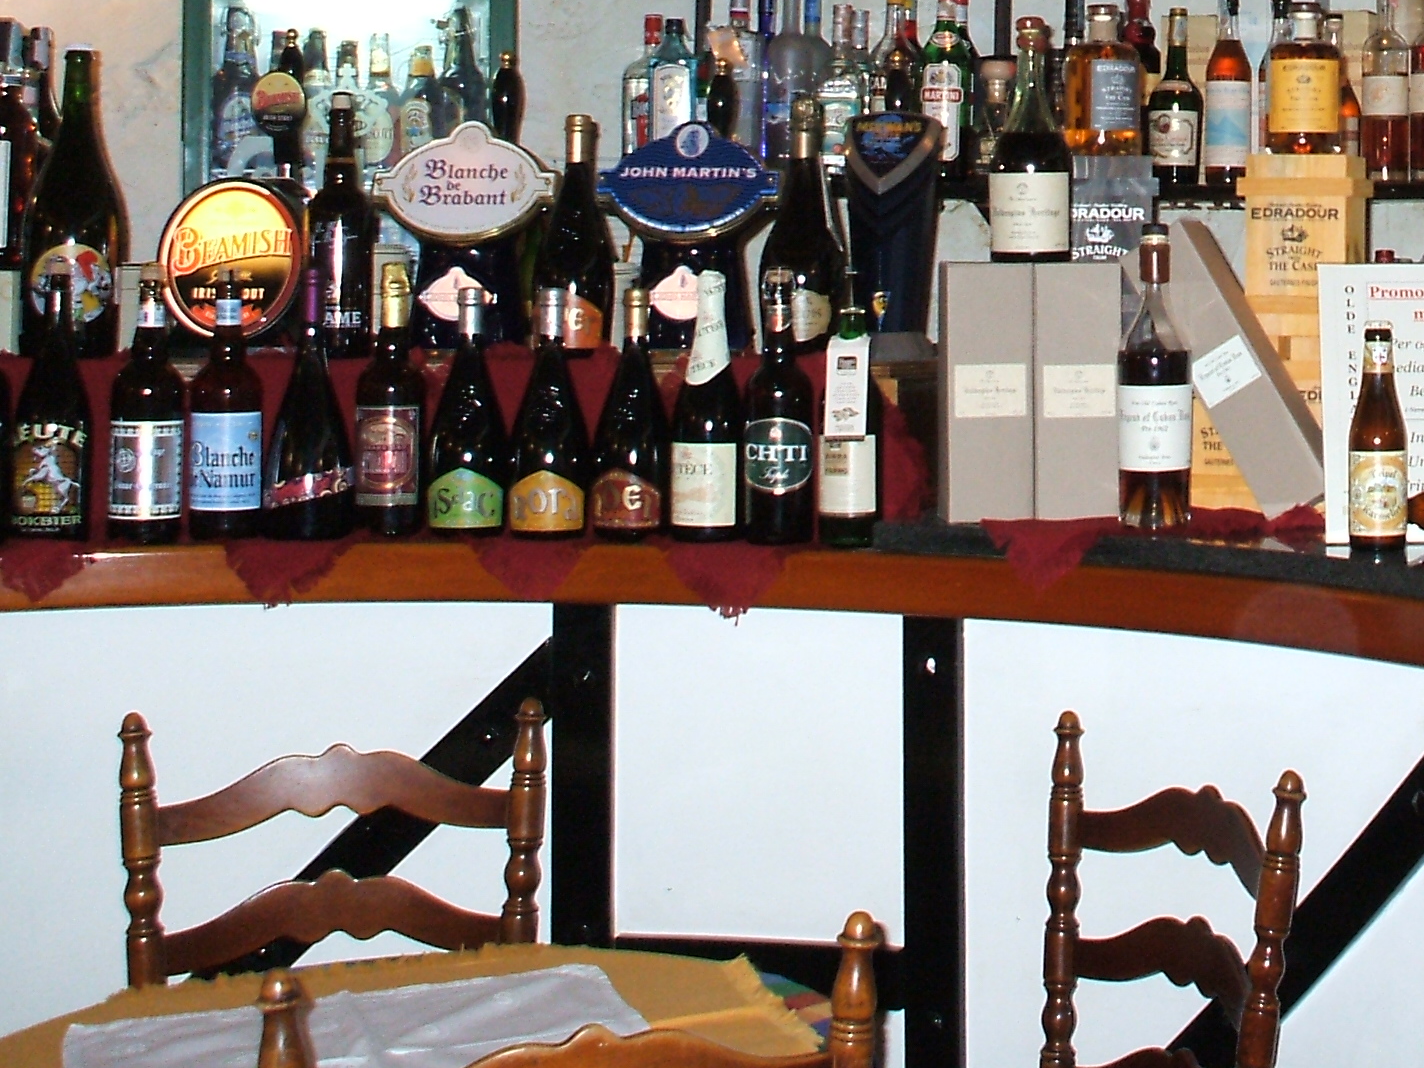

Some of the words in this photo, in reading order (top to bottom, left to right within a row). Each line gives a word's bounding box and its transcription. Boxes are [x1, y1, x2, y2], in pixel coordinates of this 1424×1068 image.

[424, 158, 509, 182] Blanche
[619, 167, 670, 178] JOHN
[672, 166, 758, 179] MARTIN'S
[417, 185, 508, 207] Brabant
[1250, 207, 1340, 221] EDRADOUR
[171, 225, 293, 276] BEAMISH
[1266, 244, 1324, 260] STRAIGHT
[1268, 261, 1290, 272] THE
[1395, 360, 1424, 373] edia
[16, 422, 88, 447] EUTE
[1410, 431, 1424, 443] In
[192, 440, 256, 468] Blanche
[199, 468, 257, 489] Namur
